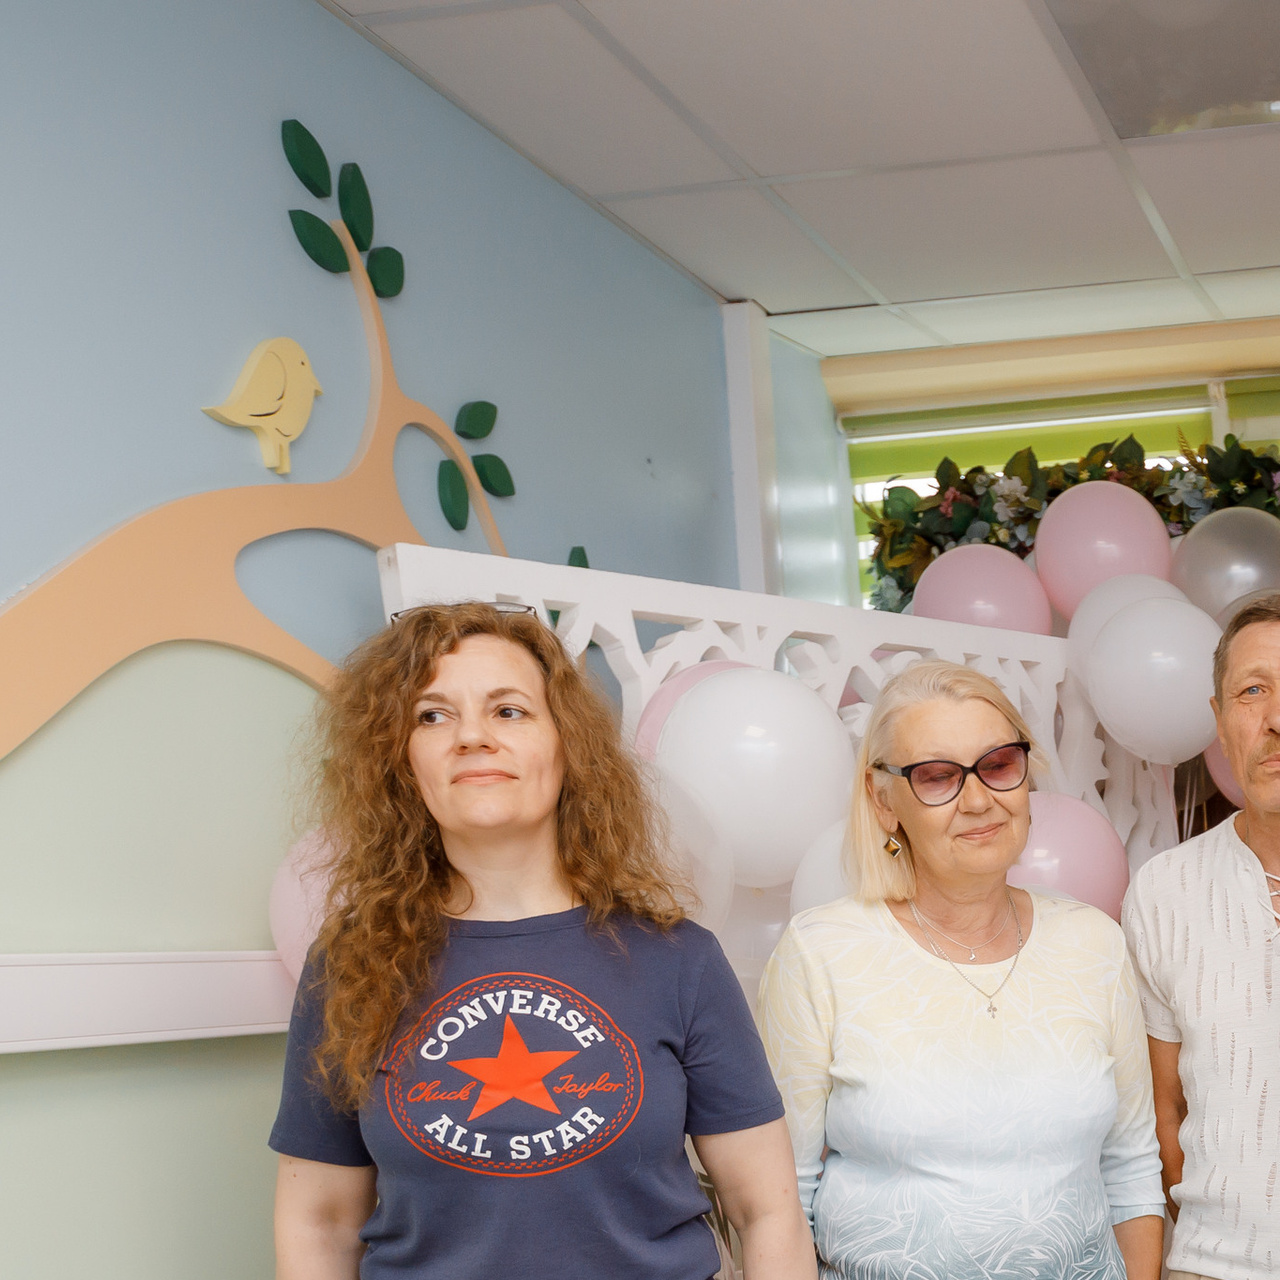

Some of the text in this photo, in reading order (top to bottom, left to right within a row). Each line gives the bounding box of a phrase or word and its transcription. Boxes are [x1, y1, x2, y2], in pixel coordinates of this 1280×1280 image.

[420, 989, 606, 1061] CONVERSE
[407, 1072, 624, 1102] Chuck Taylor
[424, 1106, 606, 1160] ALL STAR
